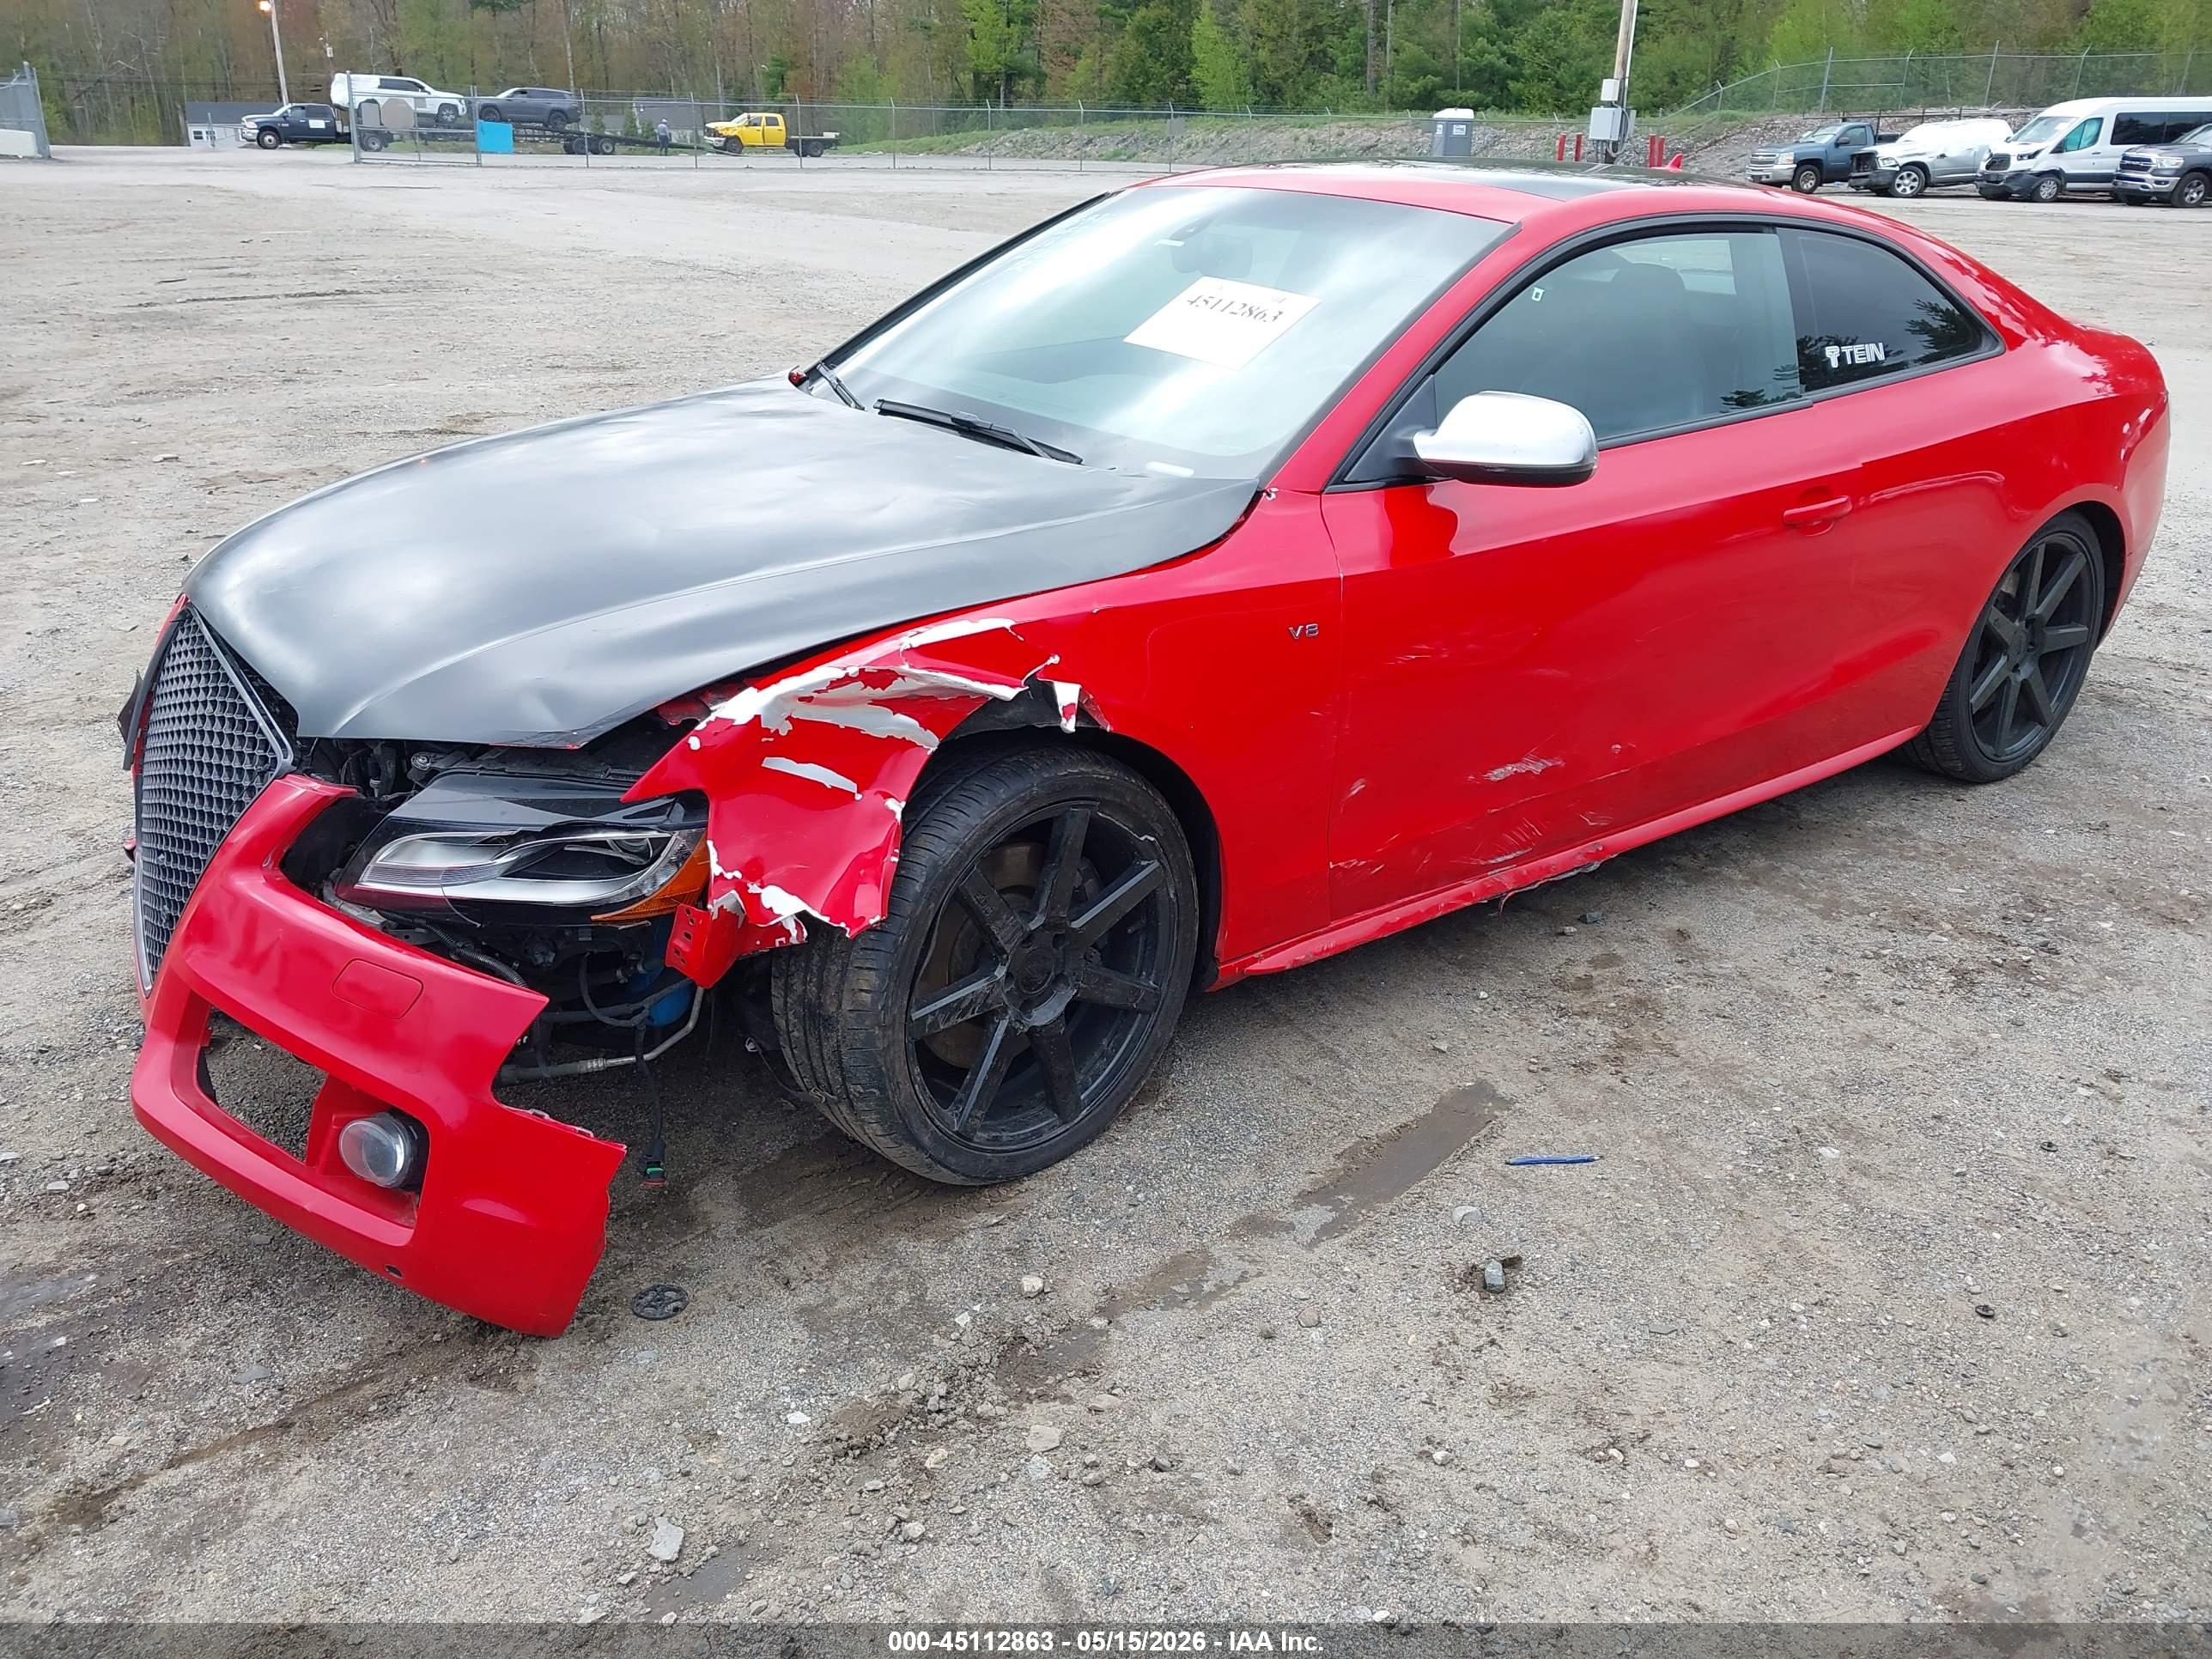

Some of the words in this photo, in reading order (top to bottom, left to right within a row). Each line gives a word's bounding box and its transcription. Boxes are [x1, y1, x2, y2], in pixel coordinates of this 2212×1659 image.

[1187, 295, 1284, 323] 45112863
[1840, 342, 1886, 365] TEIN
[1288, 623, 1319, 640] V8
